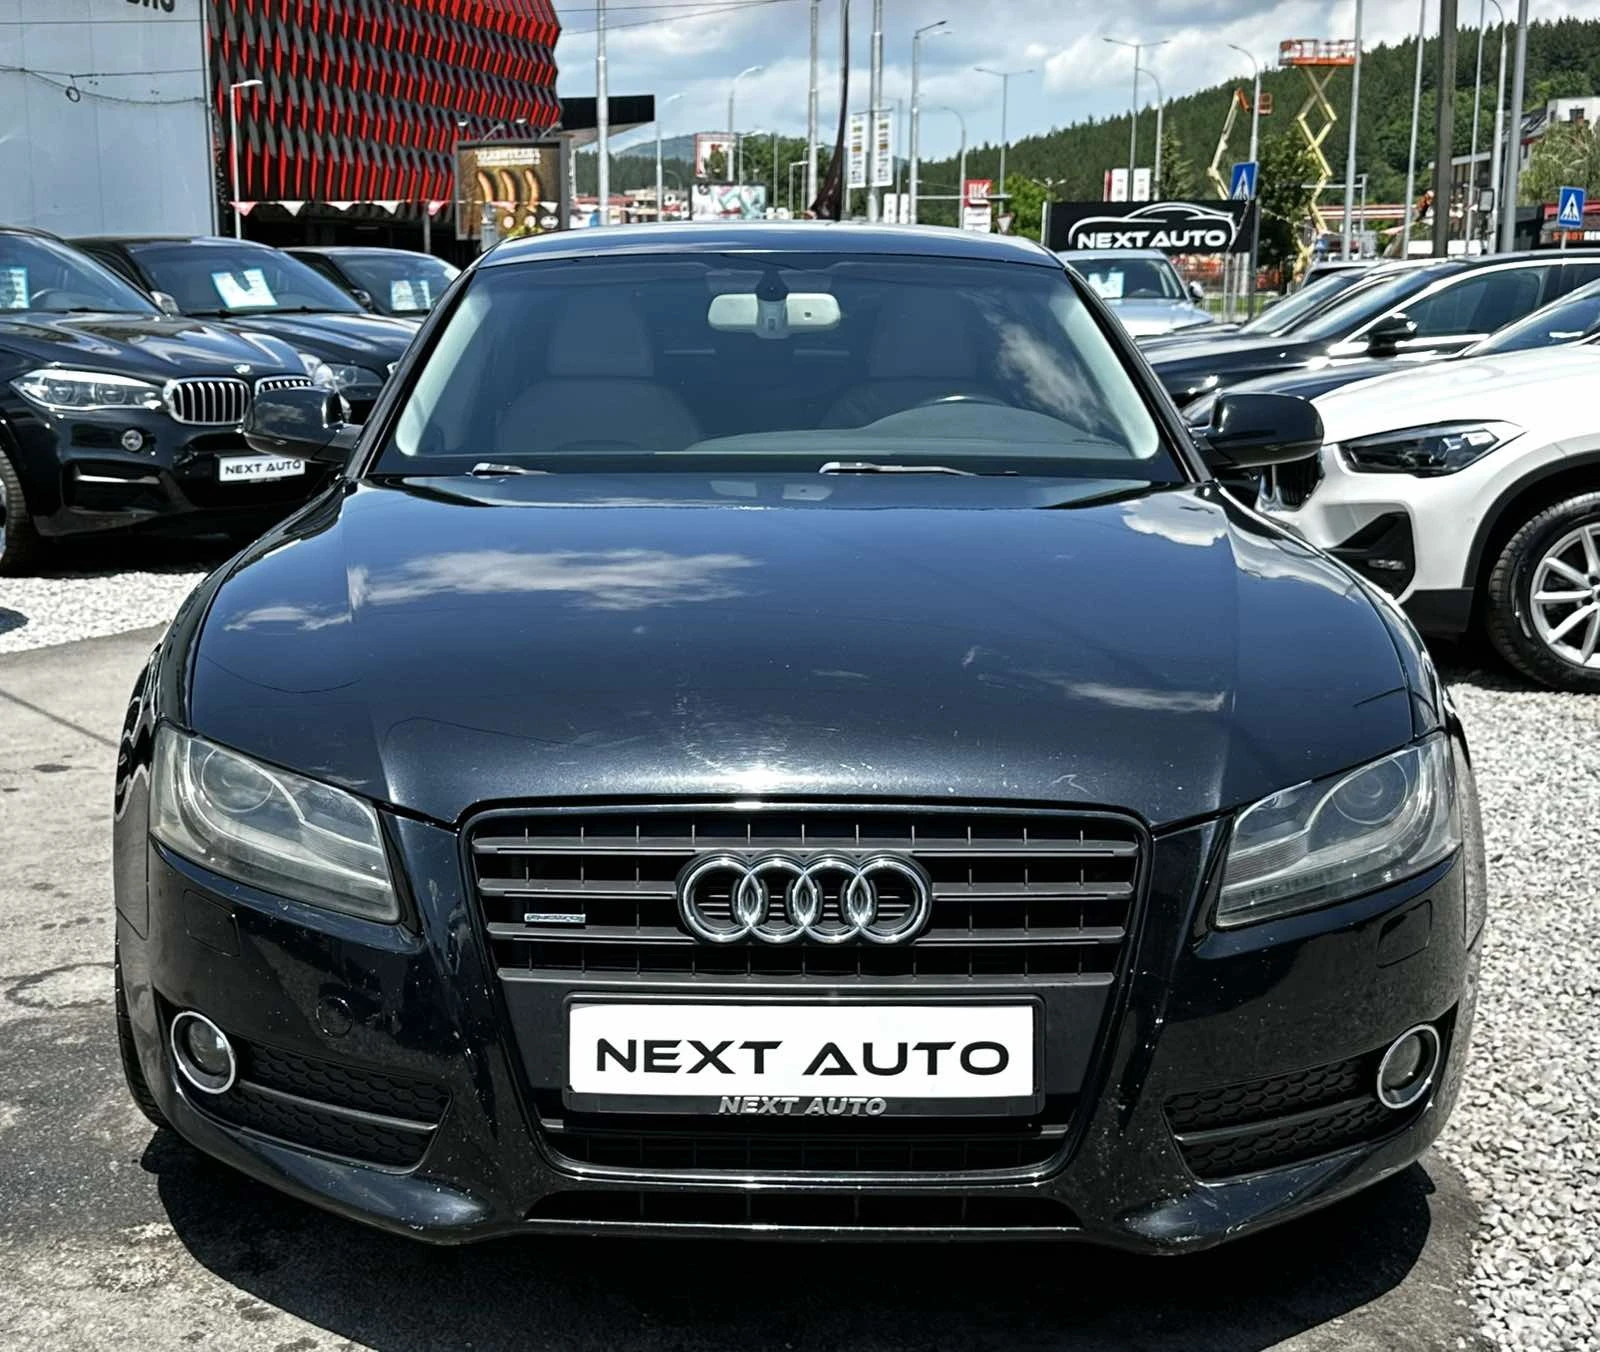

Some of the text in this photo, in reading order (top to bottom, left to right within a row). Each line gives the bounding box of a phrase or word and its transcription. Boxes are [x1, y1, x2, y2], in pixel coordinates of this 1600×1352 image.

[1077, 230, 1227, 249] NEXT AUTO
[225, 460, 302, 474] NEXT AUTO
[596, 1038, 1010, 1077] NEXT AUTO
[718, 1096, 887, 1117] NEXT AUTO
